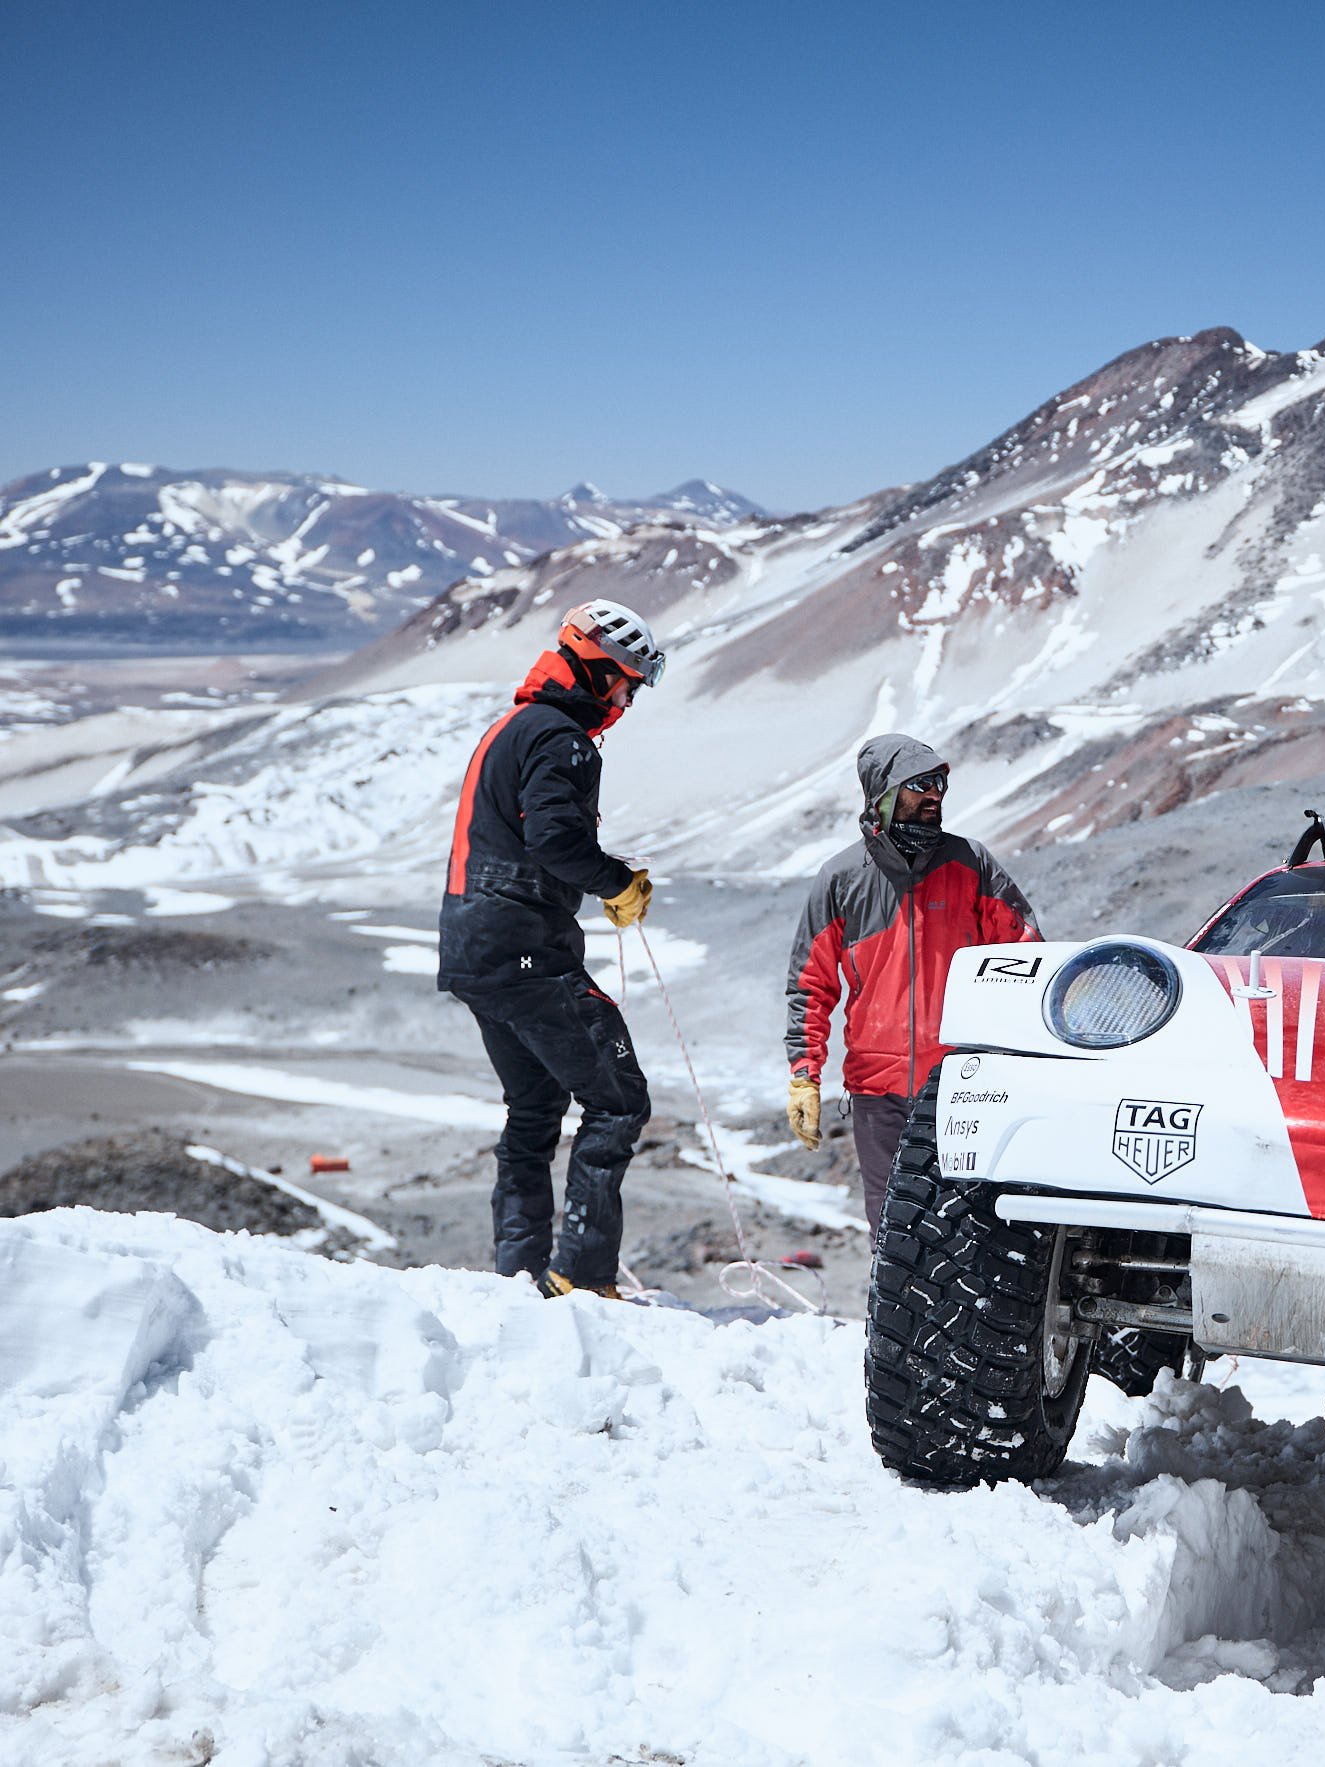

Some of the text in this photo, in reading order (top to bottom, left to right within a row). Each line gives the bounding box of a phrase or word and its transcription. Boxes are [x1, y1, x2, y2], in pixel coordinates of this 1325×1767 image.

[950, 1091, 1009, 1104] BFGoodrich
[944, 1115, 980, 1140] Ansys
[1126, 1104, 1192, 1130] TAG
[941, 1151, 965, 1171] Mobil
[1118, 1136, 1190, 1177] HEUER
